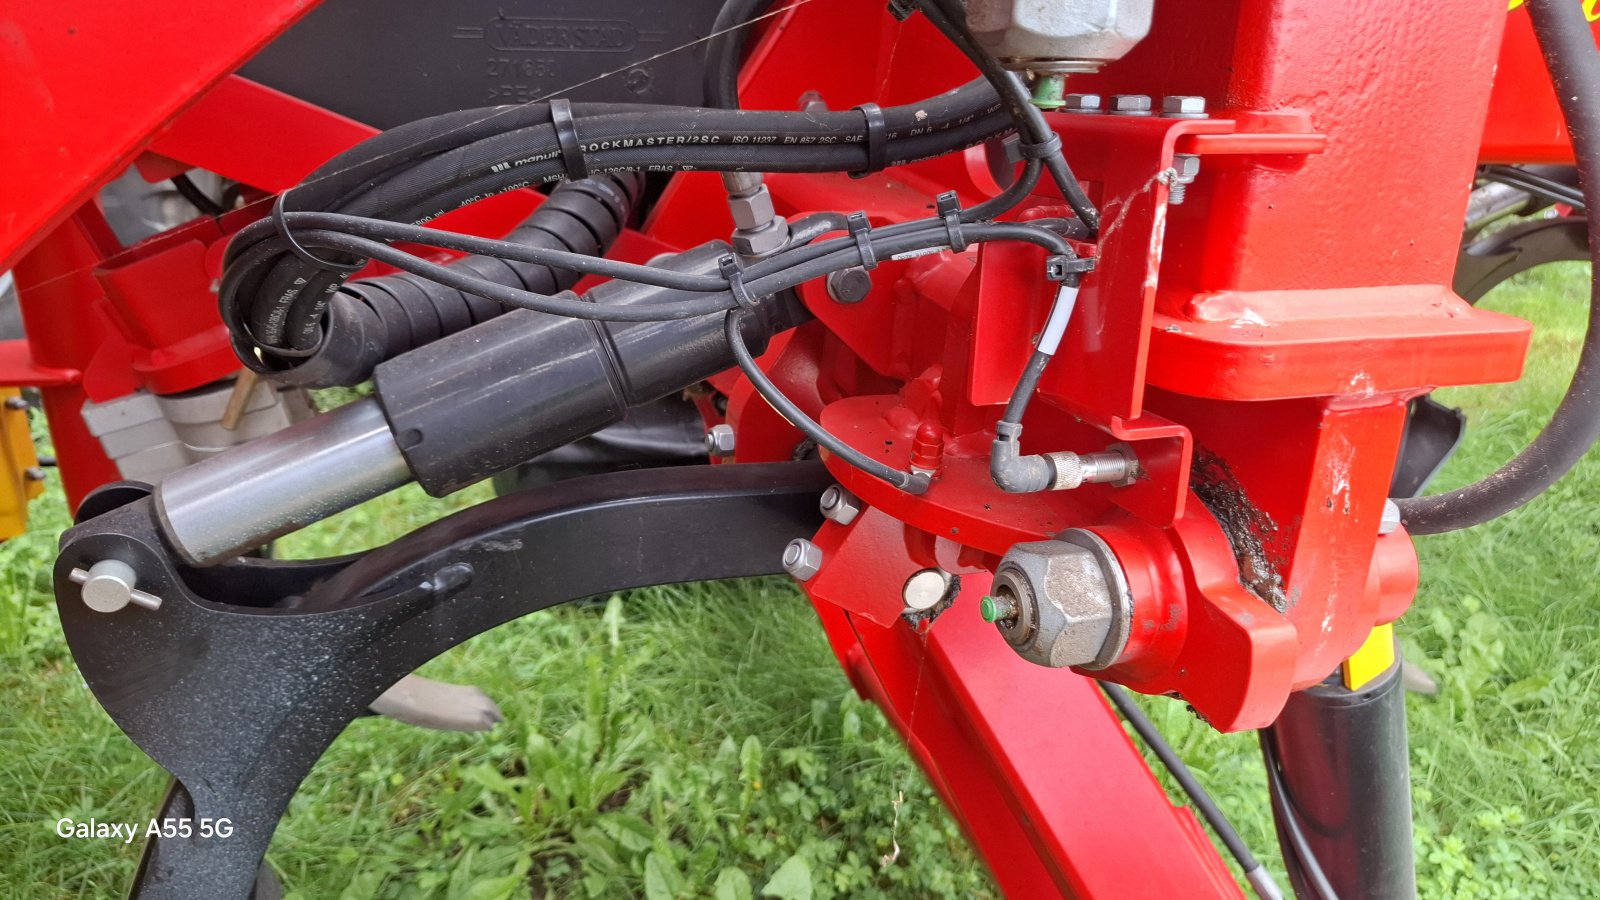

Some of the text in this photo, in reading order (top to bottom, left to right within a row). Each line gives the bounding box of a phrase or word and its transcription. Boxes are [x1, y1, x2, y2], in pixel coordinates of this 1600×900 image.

[732, 135, 749, 144] ISO
[752, 136, 777, 144] 11237
[784, 136, 798, 144] EN
